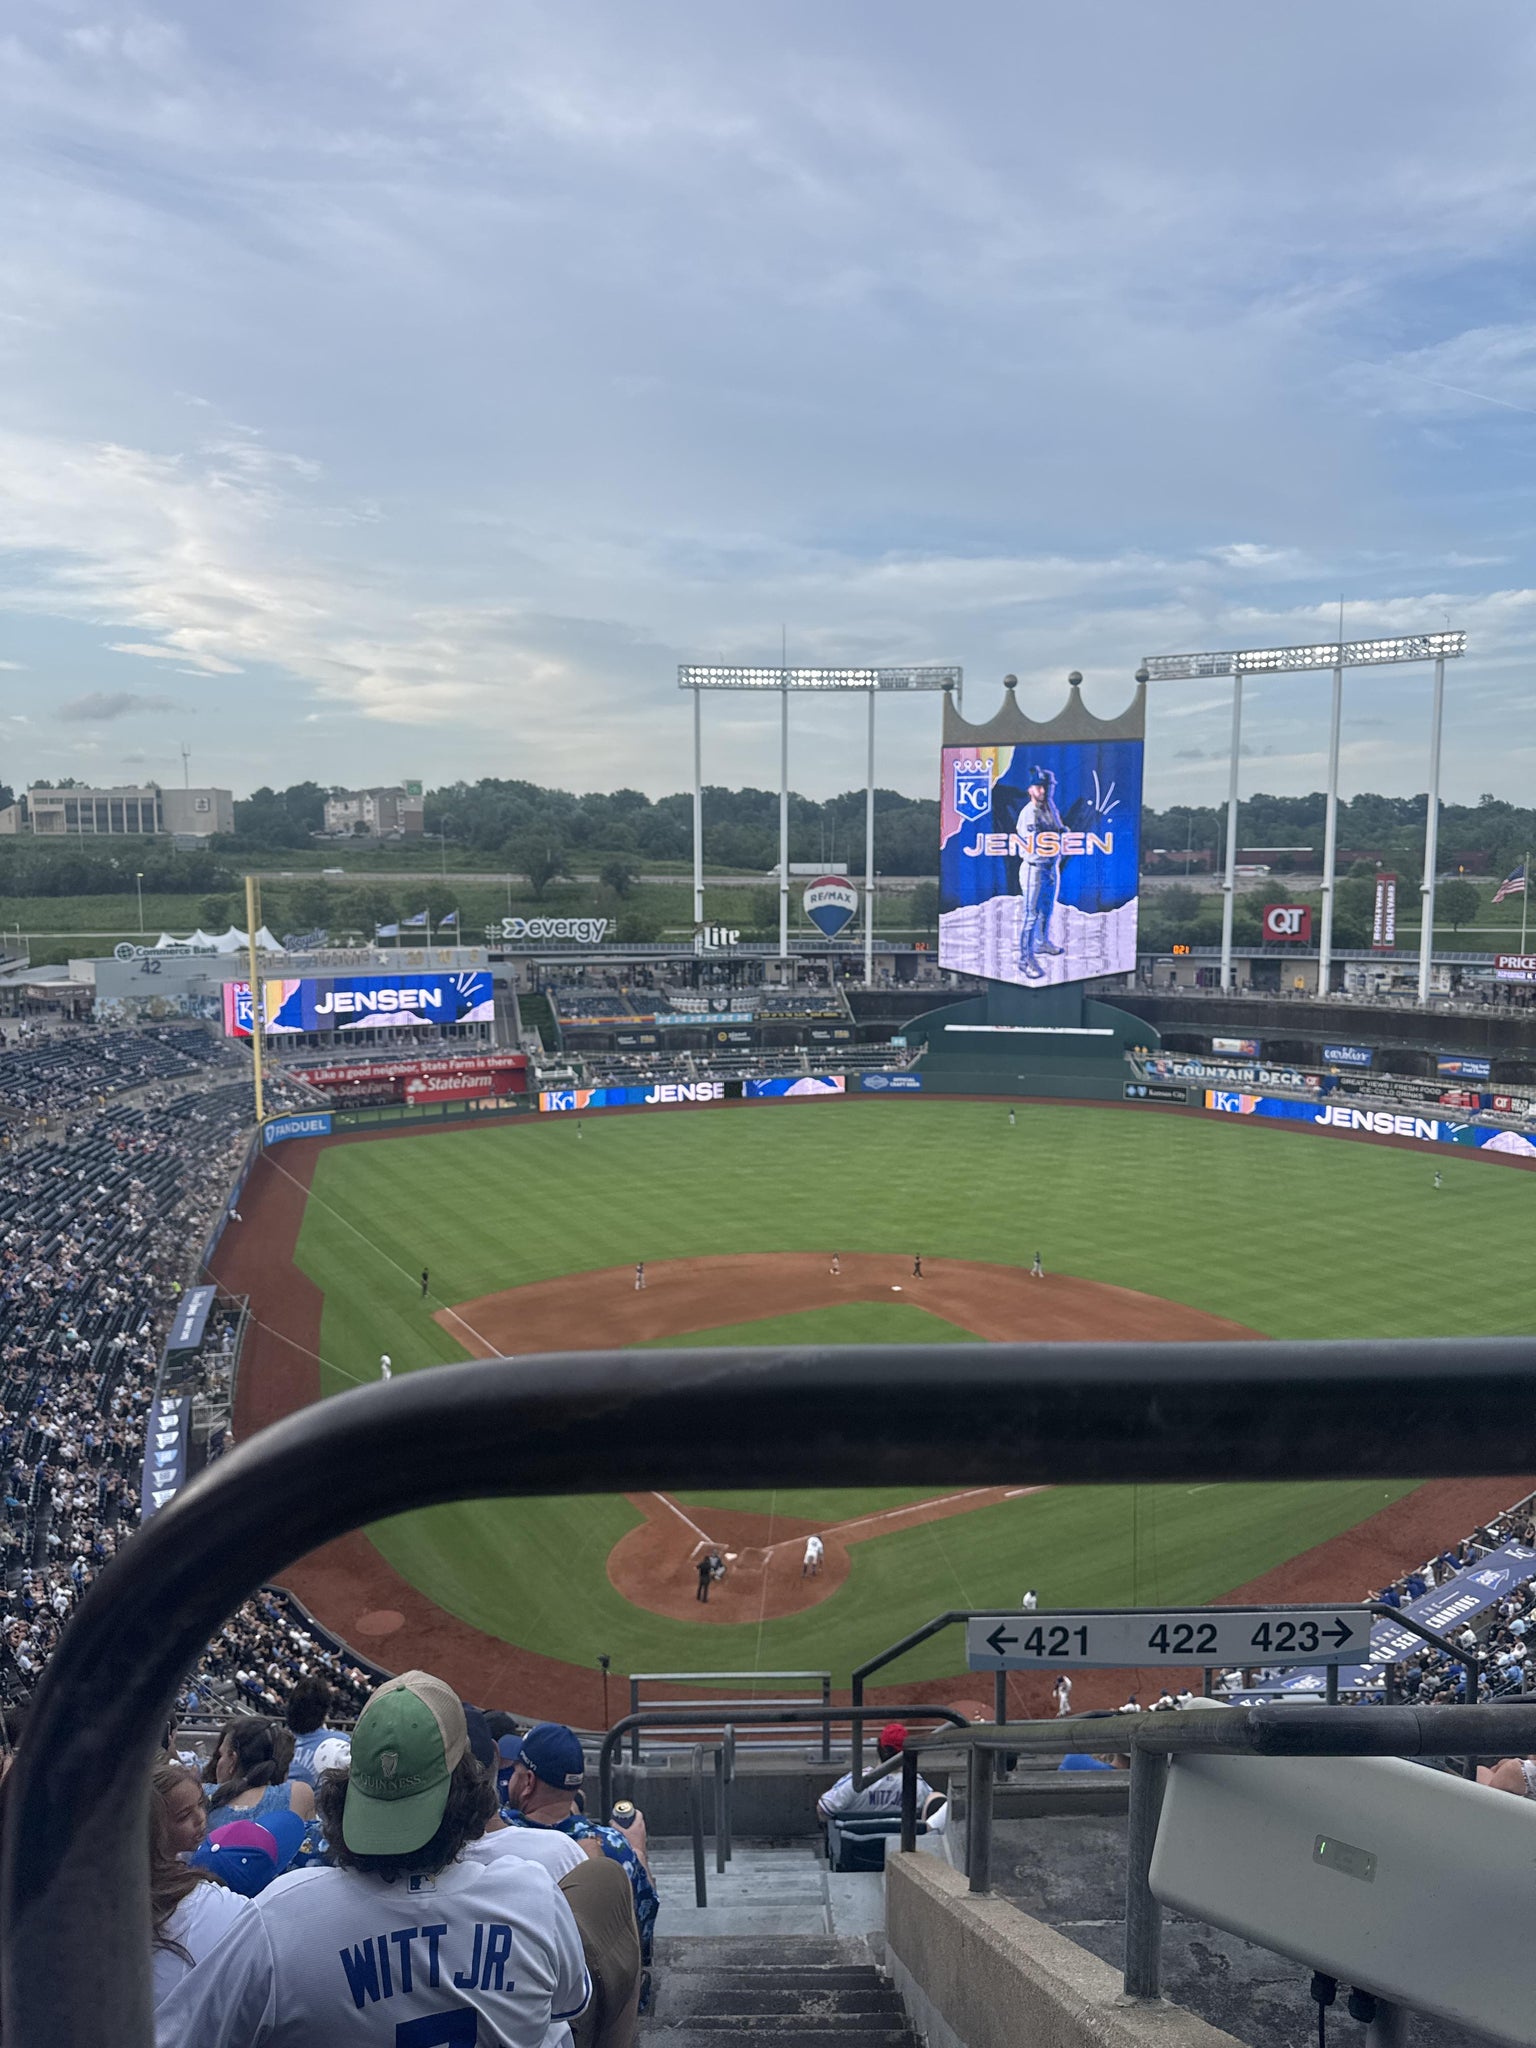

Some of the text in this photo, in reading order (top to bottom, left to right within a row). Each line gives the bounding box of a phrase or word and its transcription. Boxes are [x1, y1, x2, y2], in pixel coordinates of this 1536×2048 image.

[958, 782, 988, 811] KC
[963, 831, 1113, 857] JENSEN
[810, 892, 851, 903] RE/MAX
[1267, 908, 1304, 934] QT
[1373, 885, 1384, 940] BOULEVARD
[1385, 885, 1396, 940] BOULEVARD
[529, 919, 606, 942] evergy
[703, 926, 741, 949] Lite
[136, 945, 218, 956] Commerce Bank
[140, 960, 162, 974] 42
[1499, 956, 1536, 970] PRICE
[314, 987, 442, 1014] JENSEN
[314, 1068, 336, 1081] Like
[347, 1066, 371, 1080] good
[421, 1060, 448, 1071] State
[450, 1058, 475, 1069] Farm
[477, 1058, 485, 1067] is
[487, 1055, 516, 1067] there.
[1174, 1064, 1306, 1085] FOUNTAIN DECK
[645, 1082, 746, 1104] JENSE
[1340, 1078, 1441, 1095] GREAT VIEWS FRESH FOOD
[550, 1091, 574, 1111] KC
[1215, 1091, 1240, 1112] KC
[275, 1119, 327, 1136] FANDUEL
[1314, 1105, 1439, 1141] JENSEN
[1425, 1594, 1481, 1629] CHAMPIONS
[1024, 1621, 1319, 1656] 421 422 423
[360, 1773, 422, 1790] GUINNESS
[339, 1923, 515, 2009] WITT JR.
